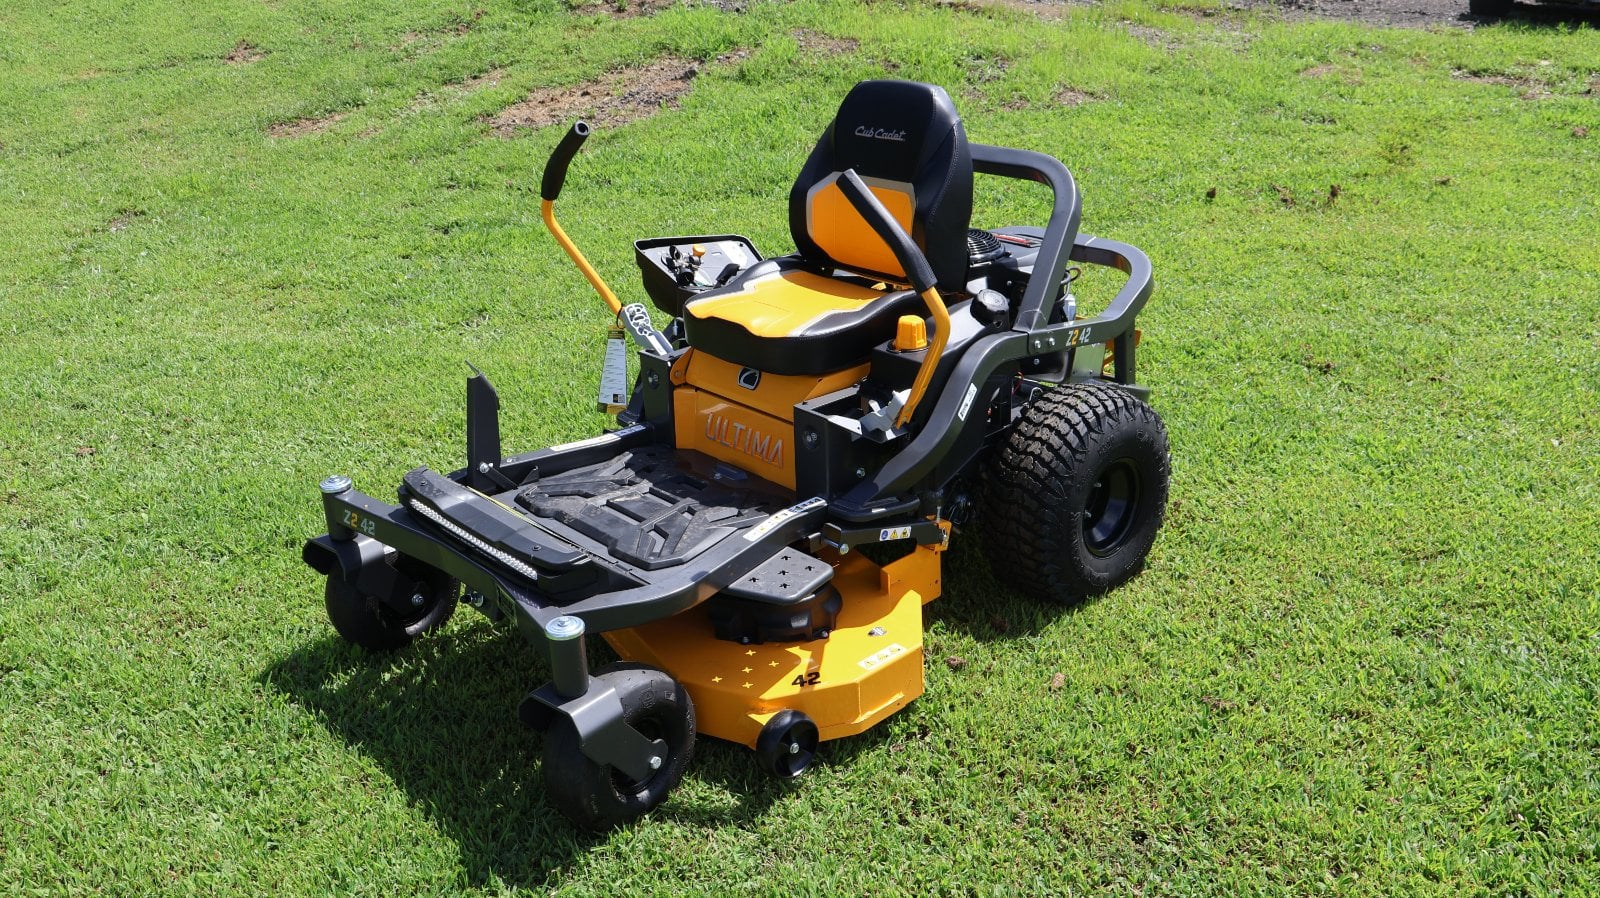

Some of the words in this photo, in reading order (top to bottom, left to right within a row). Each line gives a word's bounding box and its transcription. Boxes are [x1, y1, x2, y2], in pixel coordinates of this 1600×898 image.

[855, 126, 874, 138] Cub
[874, 128, 907, 141] Cadet
[1065, 329, 1079, 347] Z2
[1079, 327, 1092, 343] 42
[706, 412, 784, 468] ULTIMA
[343, 510, 358, 528] Z2
[360, 518, 376, 536] 42
[791, 671, 822, 687] 42
